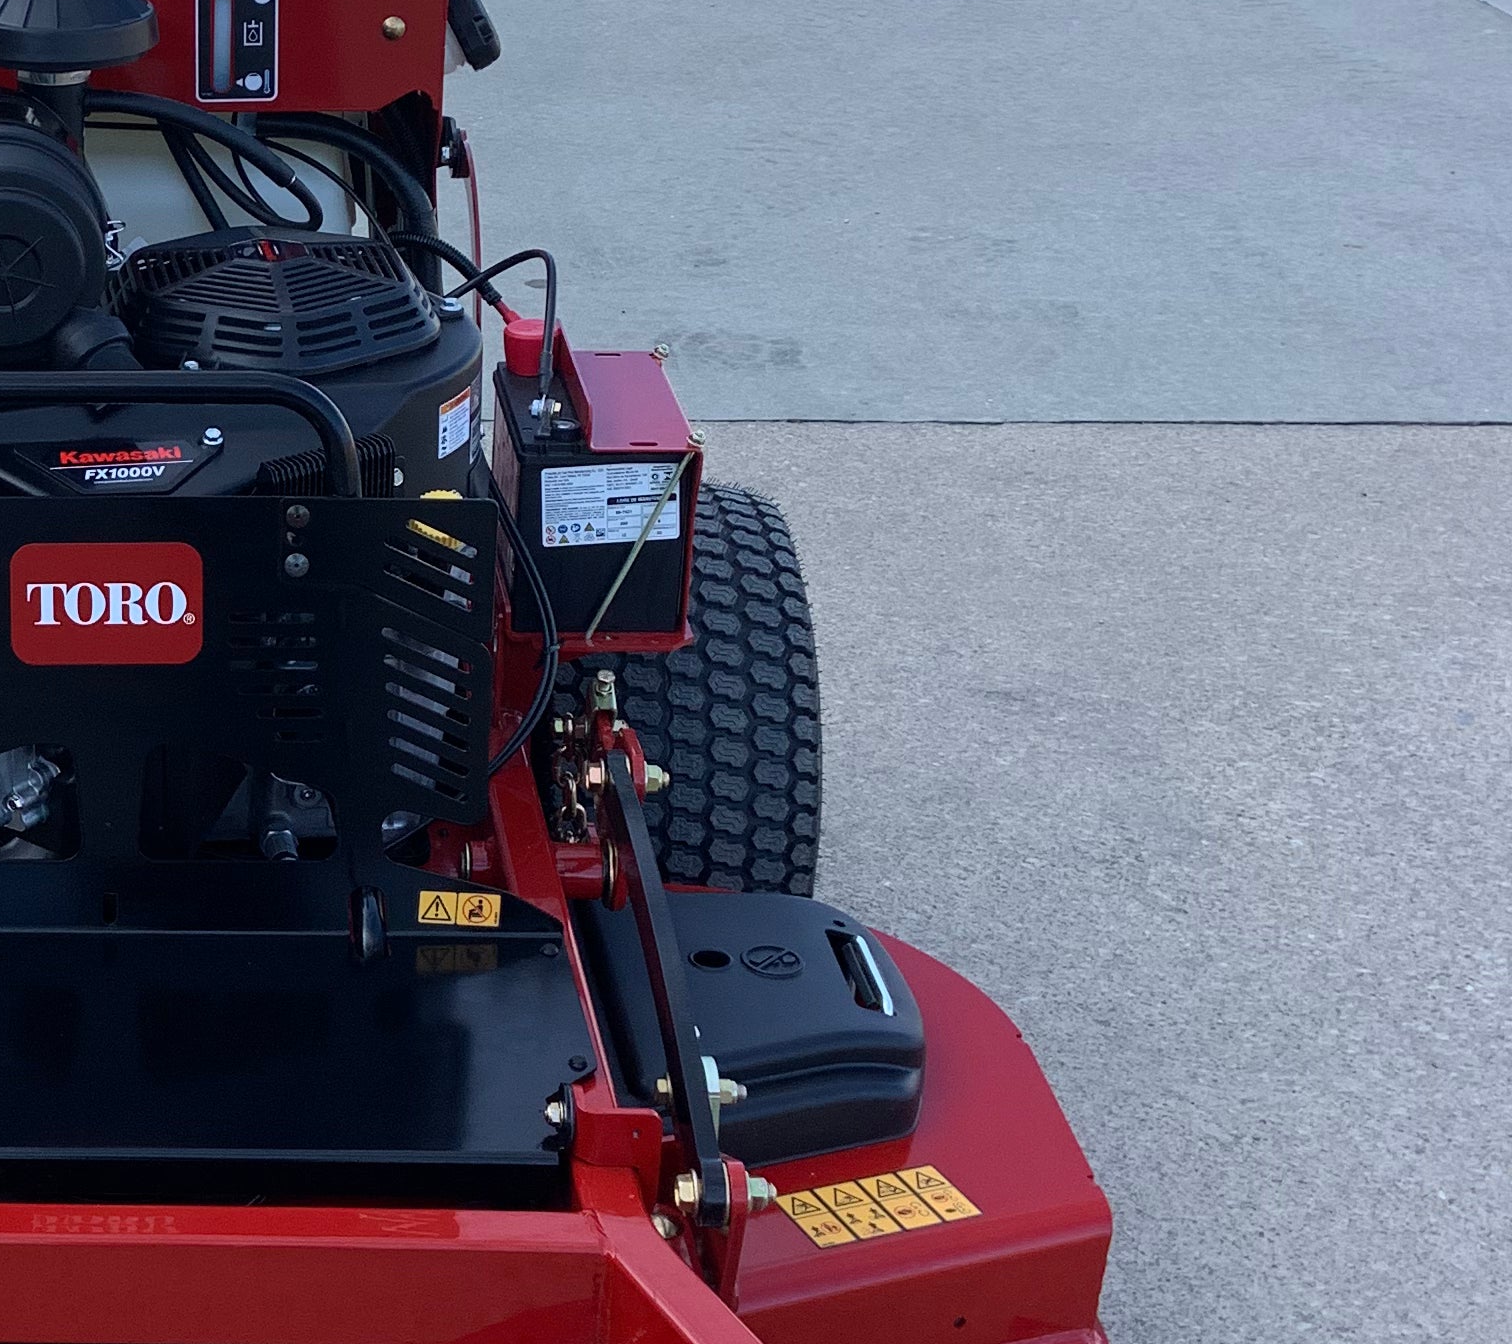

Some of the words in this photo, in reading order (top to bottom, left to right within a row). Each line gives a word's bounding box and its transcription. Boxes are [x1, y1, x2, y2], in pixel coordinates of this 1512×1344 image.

[59, 446, 182, 464] Kawasaki
[84, 465, 165, 480] FX1000V
[26, 582, 188, 626] TORO
